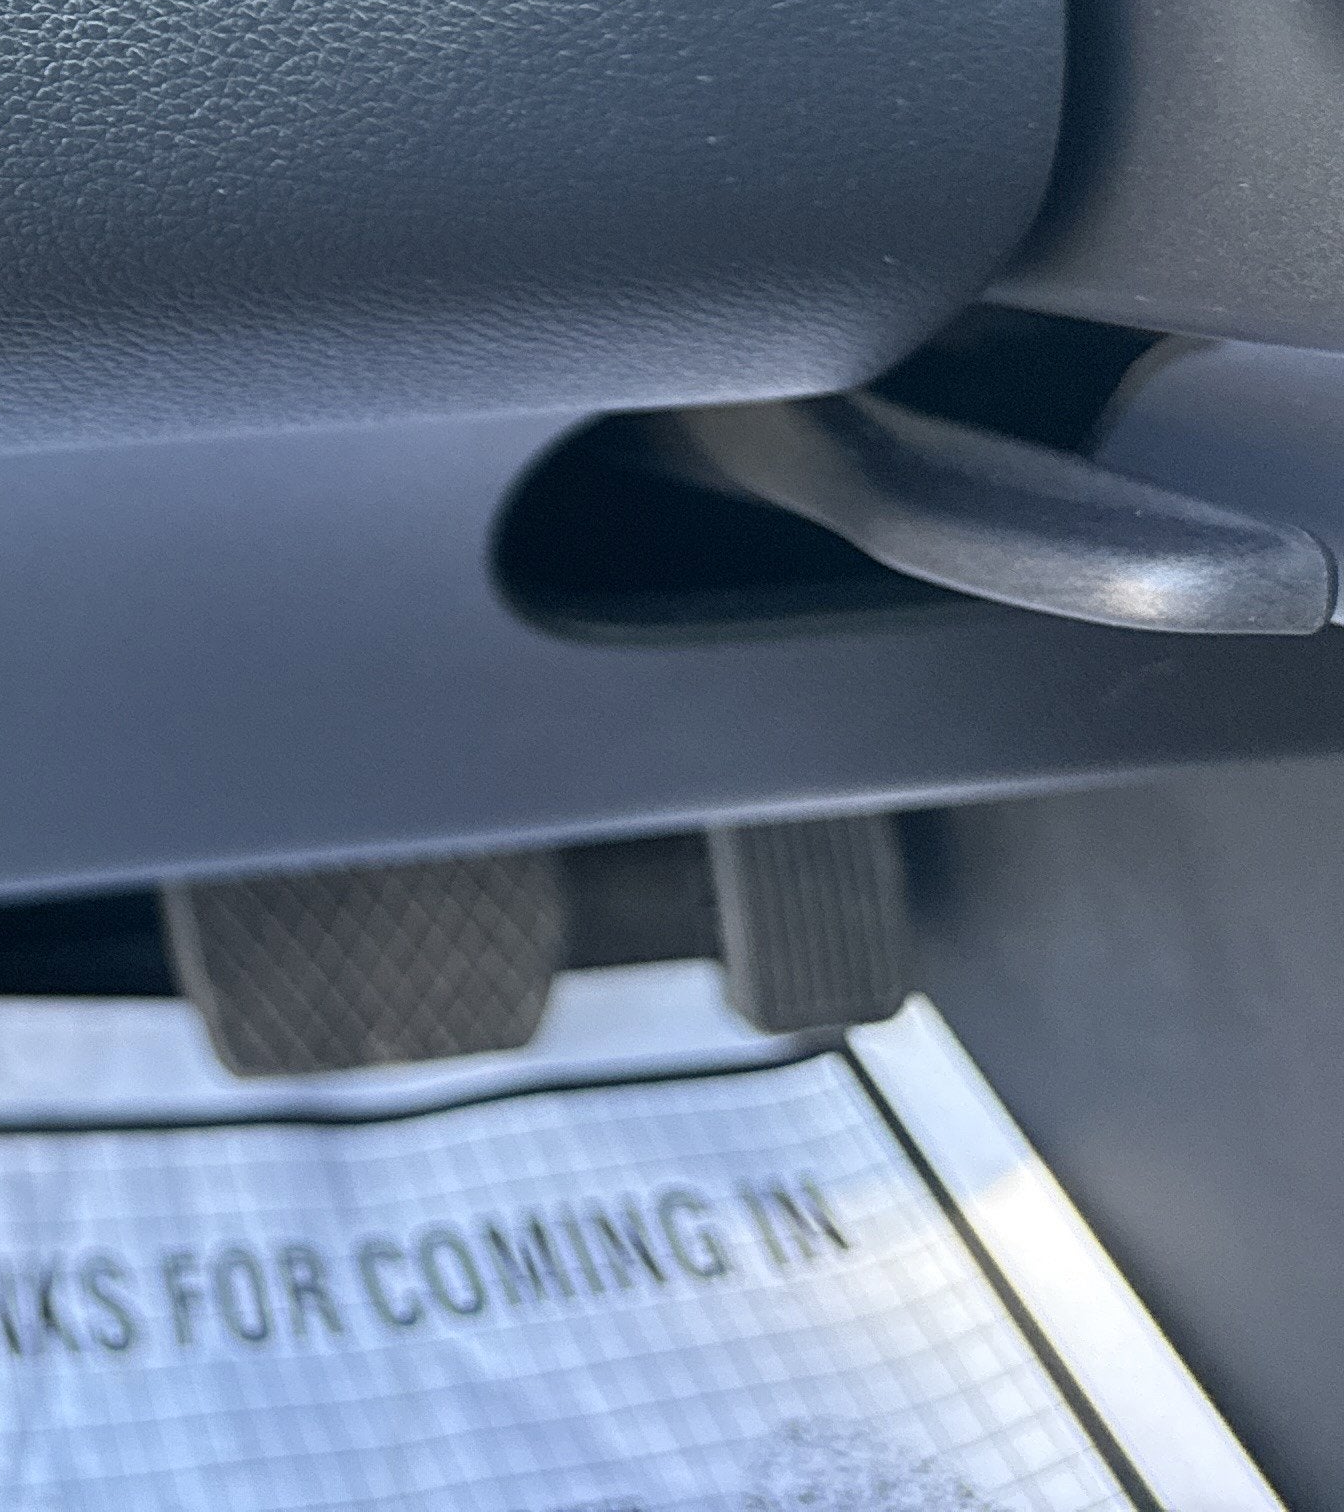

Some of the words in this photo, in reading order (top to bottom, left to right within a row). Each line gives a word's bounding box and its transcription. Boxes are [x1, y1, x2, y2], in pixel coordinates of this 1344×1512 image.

[162, 1238, 343, 1348] FOR
[354, 1184, 730, 1328] COMING
[740, 1174, 850, 1268] IN
